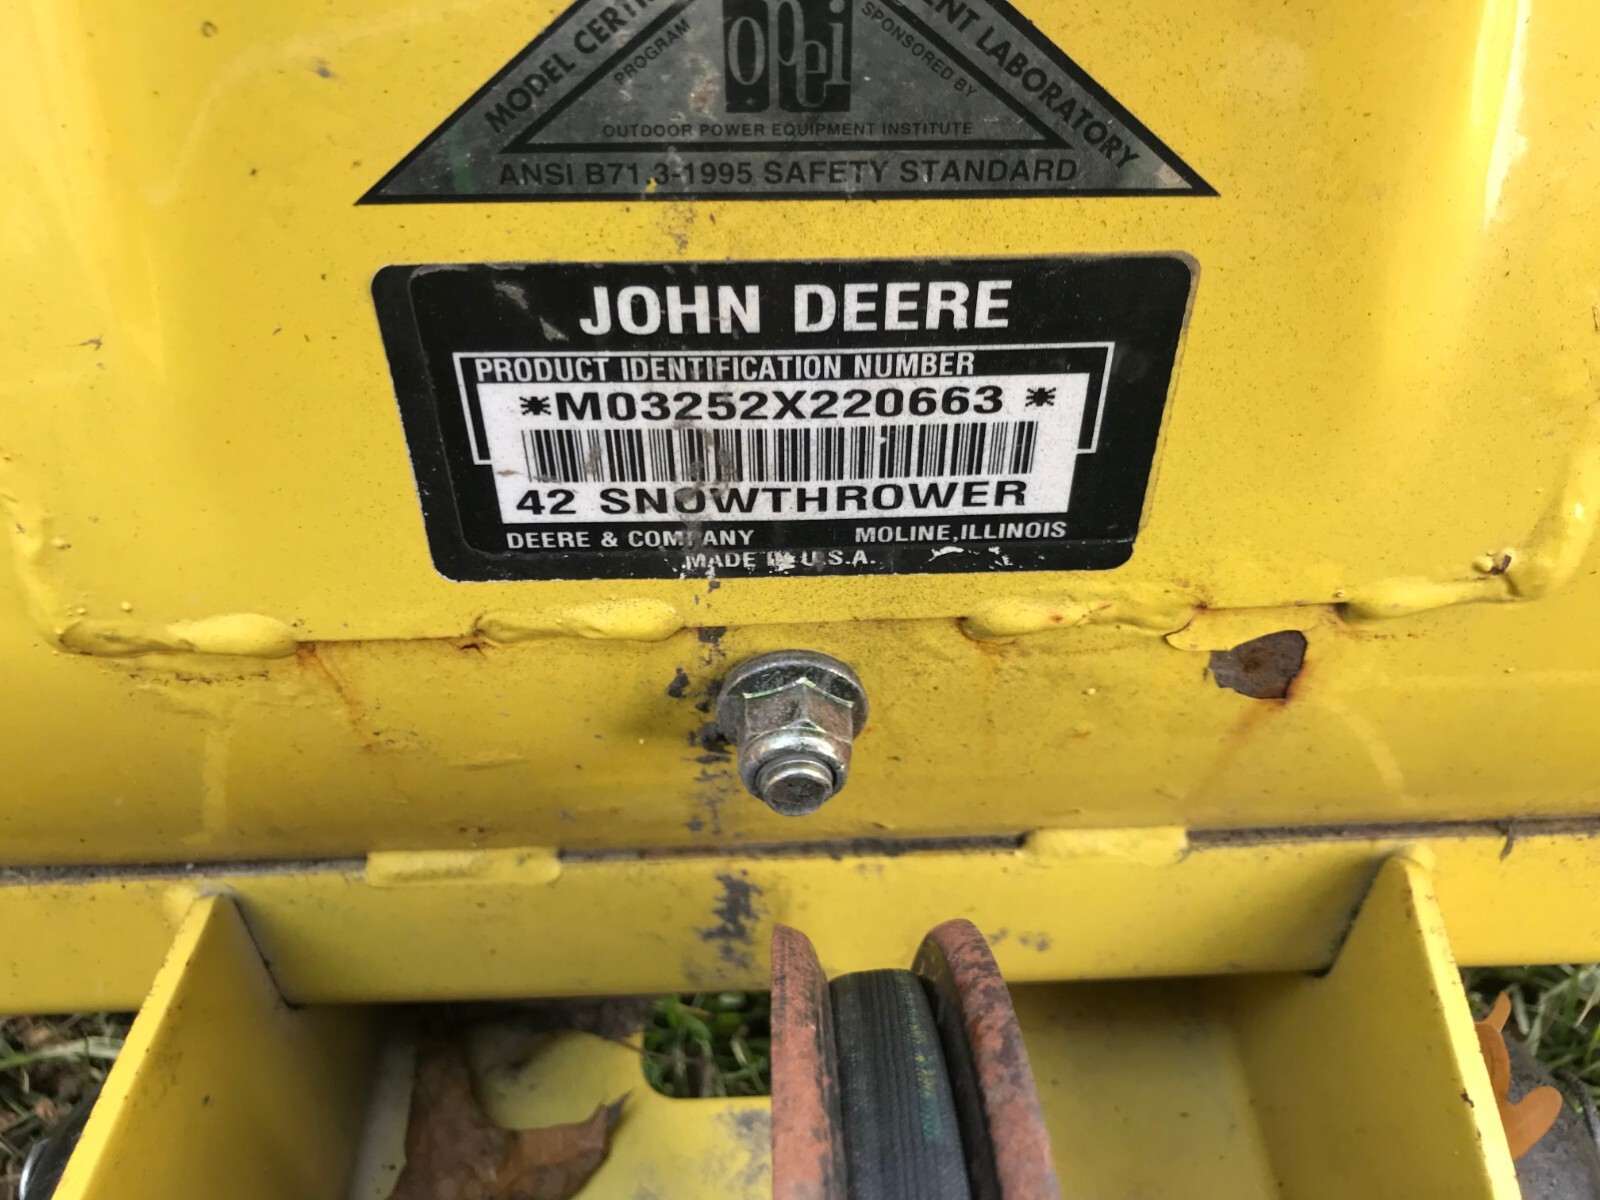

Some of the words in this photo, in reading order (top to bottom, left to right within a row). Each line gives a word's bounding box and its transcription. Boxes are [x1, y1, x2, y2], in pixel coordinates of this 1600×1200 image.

[484, 53, 576, 134] MODEL
[573, 0, 655, 54] CERT
[614, 18, 691, 85] PROGRAM
[861, 1, 955, 80] SPONSORED
[953, 78, 977, 98] BY
[976, 26, 1140, 168] LABORATORY
[602, 123, 693, 138] OUTDOOR
[699, 122, 765, 137] POWER
[771, 121, 880, 137] EQUIPMENT
[882, 121, 974, 136] INSTITUTE
[500, 162, 574, 186] ANSI
[584, 160, 753, 186] B71.3-1995
[763, 159, 889, 185] SAFETY
[900, 158, 1078, 184] STANDARD
[579, 284, 761, 336] JOHN
[793, 279, 1013, 334] DEERE
[475, 357, 609, 383] PRODUCT
[621, 354, 842, 382] IDENTIFICATION
[853, 351, 975, 379] NUMBER
[516, 488, 578, 516] 42
[599, 479, 1028, 515] SNOWTHROWER
[506, 531, 591, 549] DEERE
[600, 531, 619, 548] &
[685, 550, 757, 568] MADE
